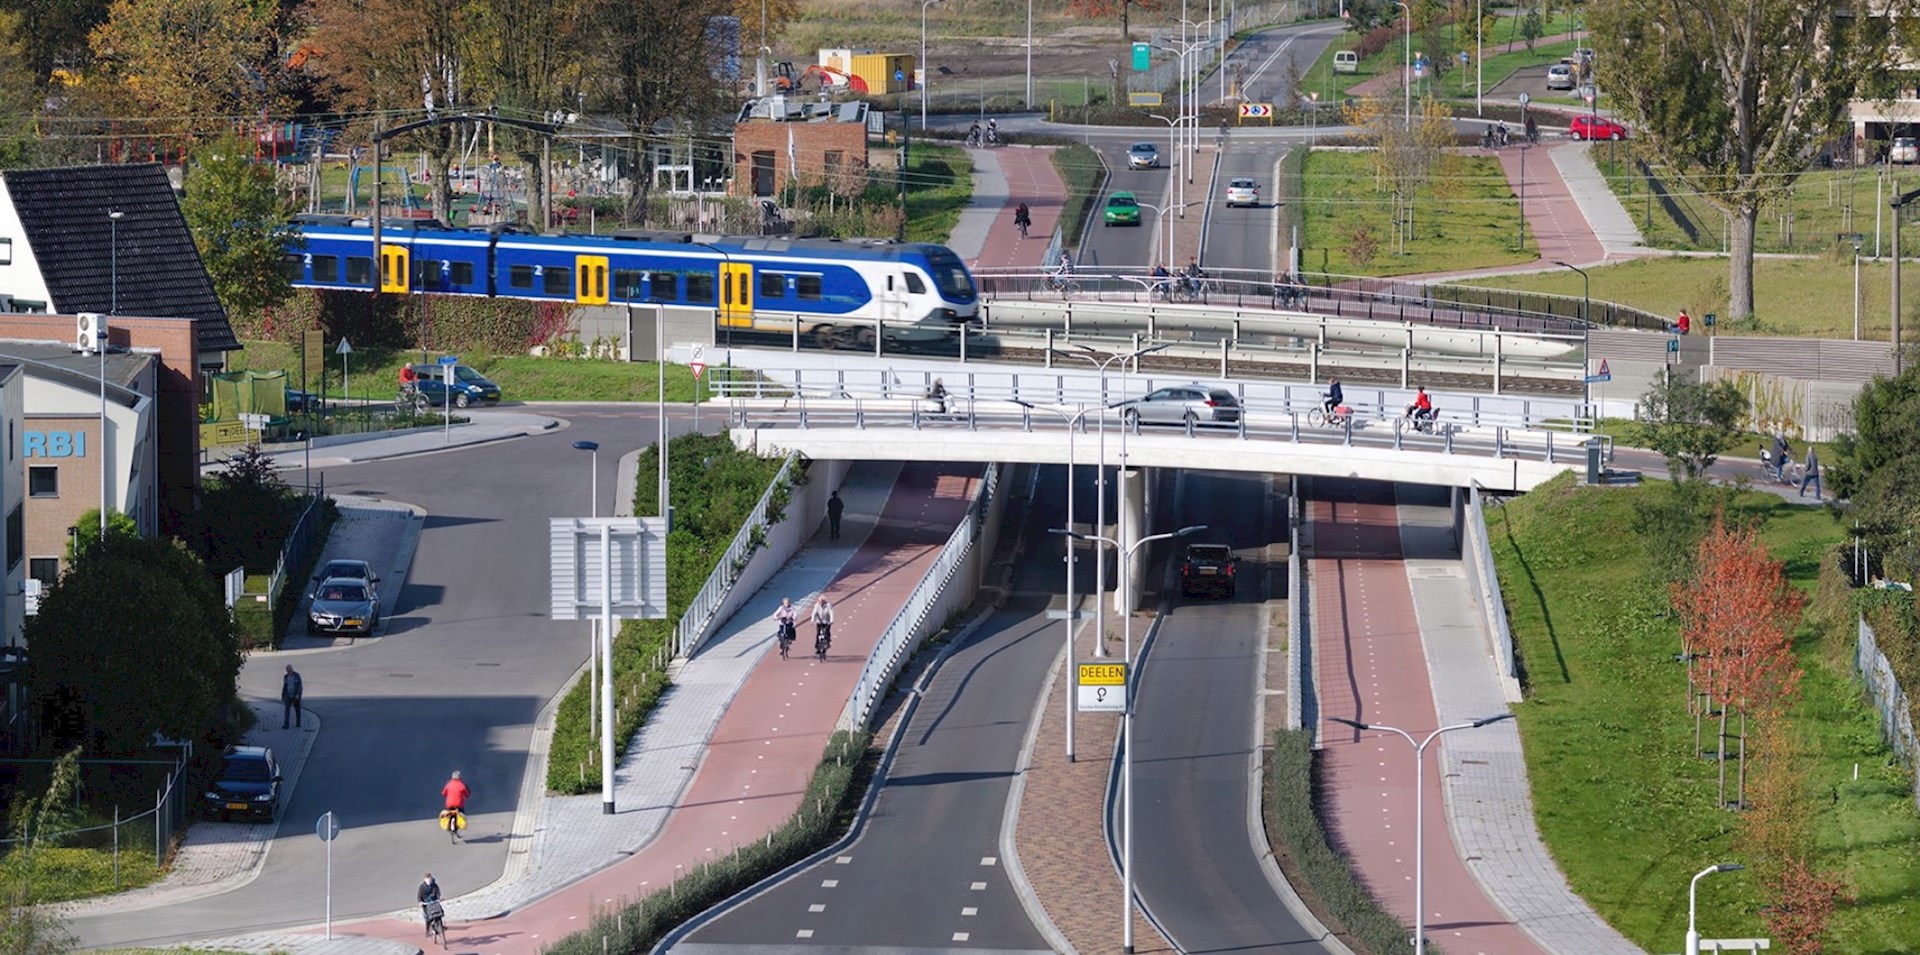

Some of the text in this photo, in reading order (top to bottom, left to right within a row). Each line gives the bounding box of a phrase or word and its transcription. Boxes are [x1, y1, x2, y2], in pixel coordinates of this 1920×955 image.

[304, 253, 313, 263] 2
[441, 260, 450, 270] 2
[534, 265, 543, 276] 2
[641, 271, 650, 281] 2
[24, 431, 86, 458] RBI
[1080, 667, 1124, 678] DEELEN
